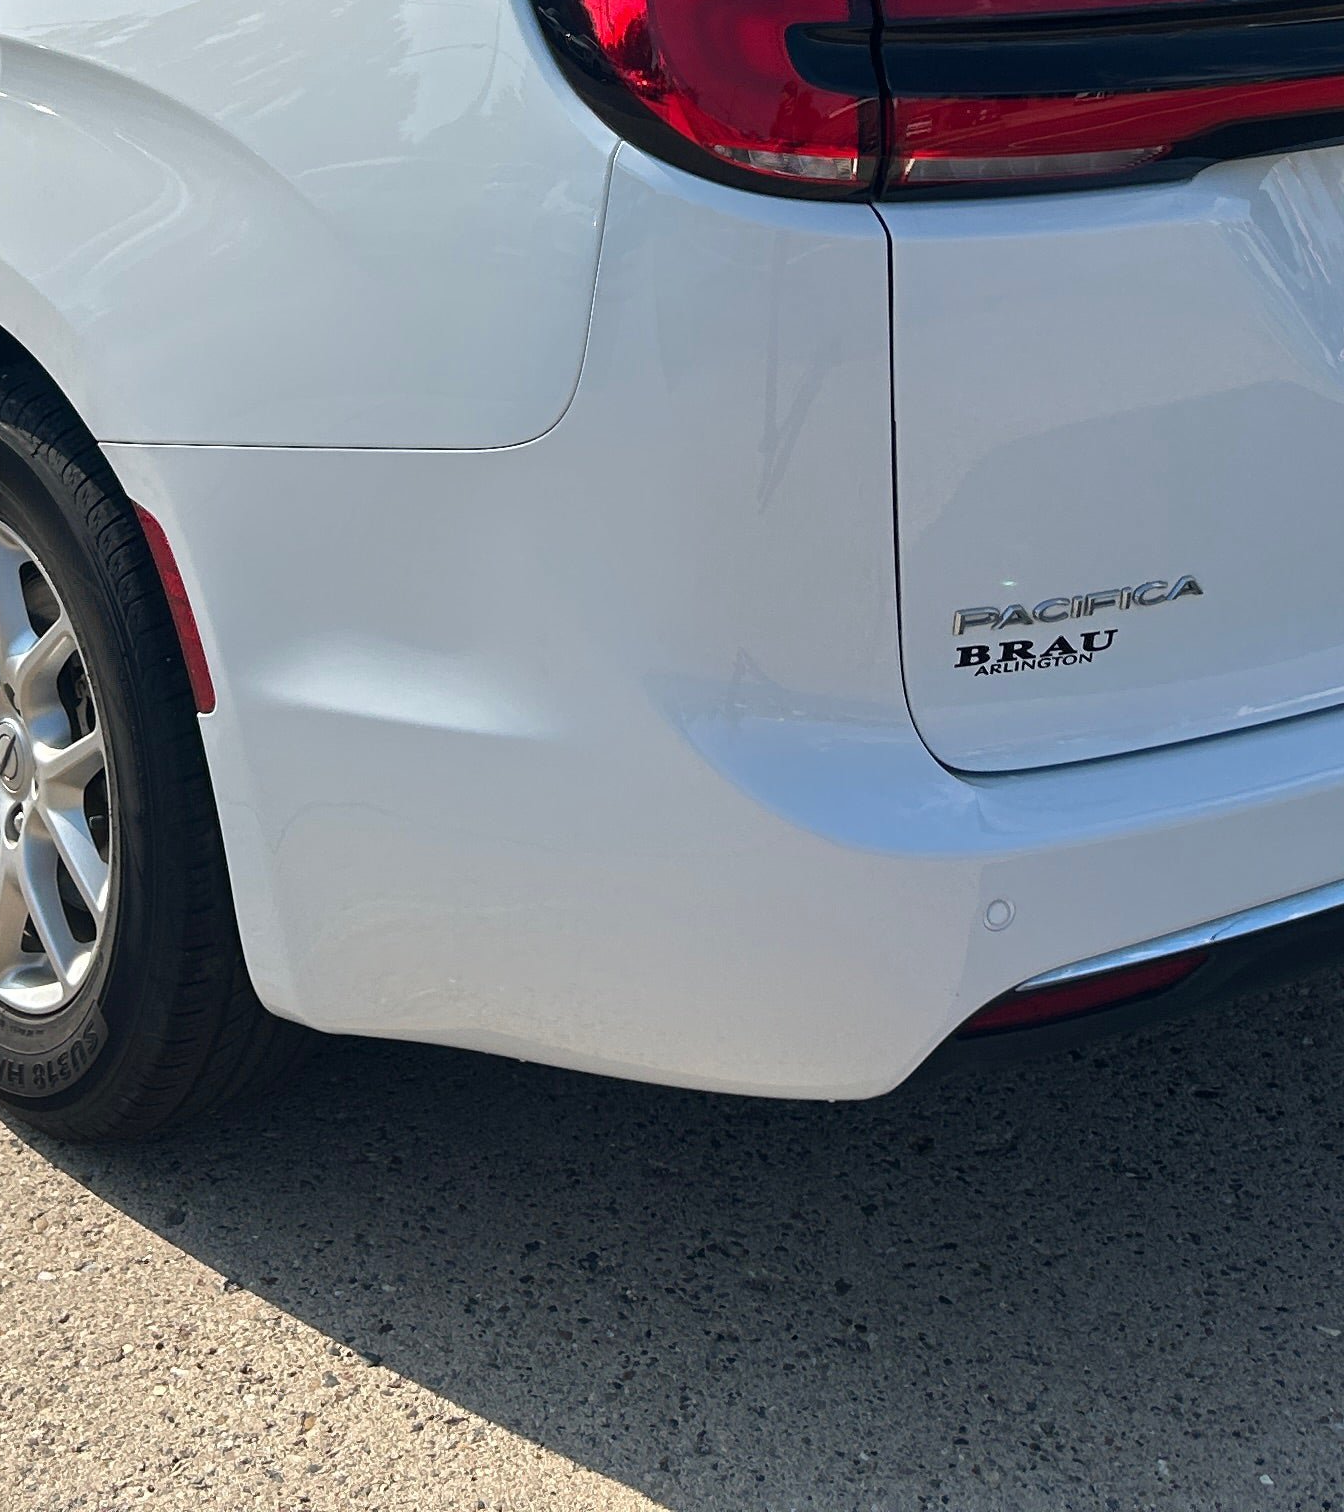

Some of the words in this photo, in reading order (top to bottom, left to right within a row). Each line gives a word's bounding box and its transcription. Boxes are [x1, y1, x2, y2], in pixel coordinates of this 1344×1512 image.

[952, 574, 1204, 636] PACIFICA
[953, 629, 1119, 668] BRAU
[973, 651, 1094, 677] ARLINGTON
